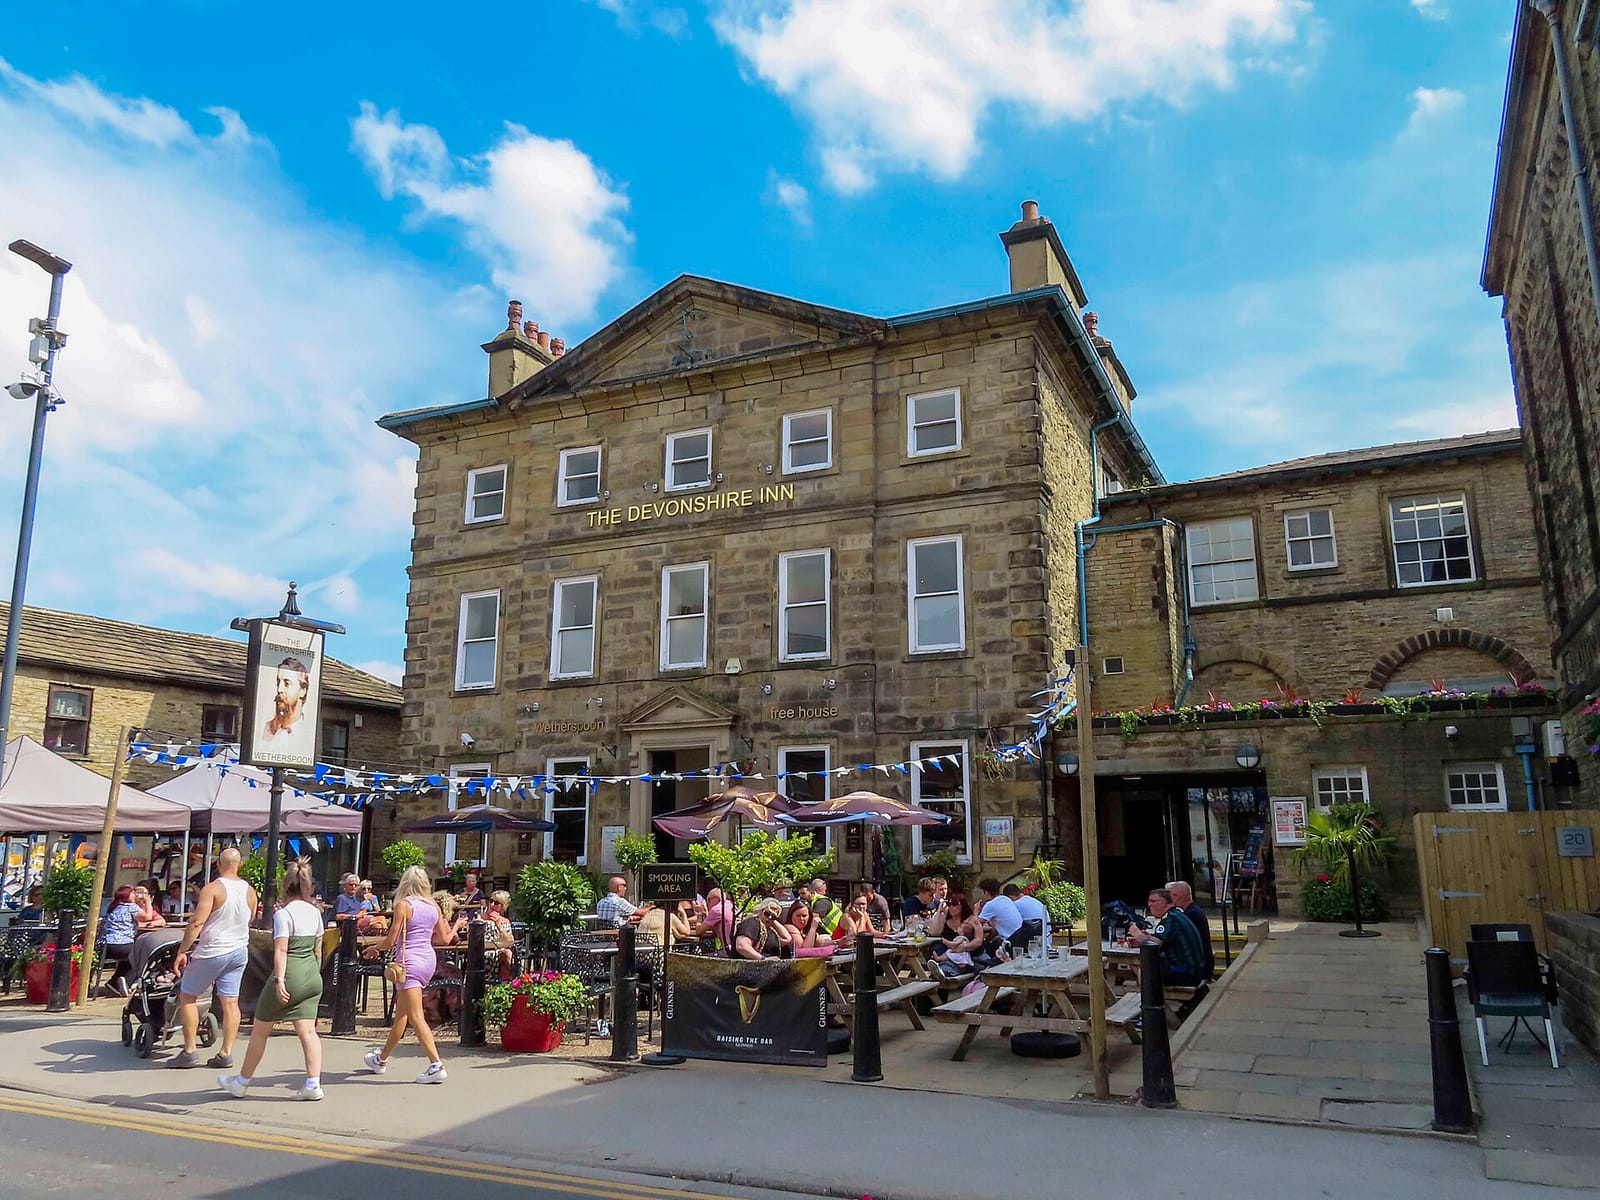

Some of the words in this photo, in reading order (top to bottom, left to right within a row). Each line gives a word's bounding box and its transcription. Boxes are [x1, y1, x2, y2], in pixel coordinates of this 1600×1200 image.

[587, 508, 622, 527] THE
[627, 489, 753, 522] DEVONSHIRE
[759, 483, 795, 504] INN
[287, 638, 301, 648] THE
[269, 643, 316, 659] DEVONSHIRE
[770, 706, 795, 719] free
[798, 705, 839, 718] house
[534, 720, 604, 734] Wetherspoon
[254, 751, 313, 764] WETHERSPOON
[1564, 833, 1585, 846] 20
[648, 873, 691, 882] SMOKING
[657, 884, 682, 893] AREA
[666, 981, 675, 1019] GUINNESS
[818, 987, 826, 1028] GUINNESS
[717, 1035, 744, 1043] RAISING
